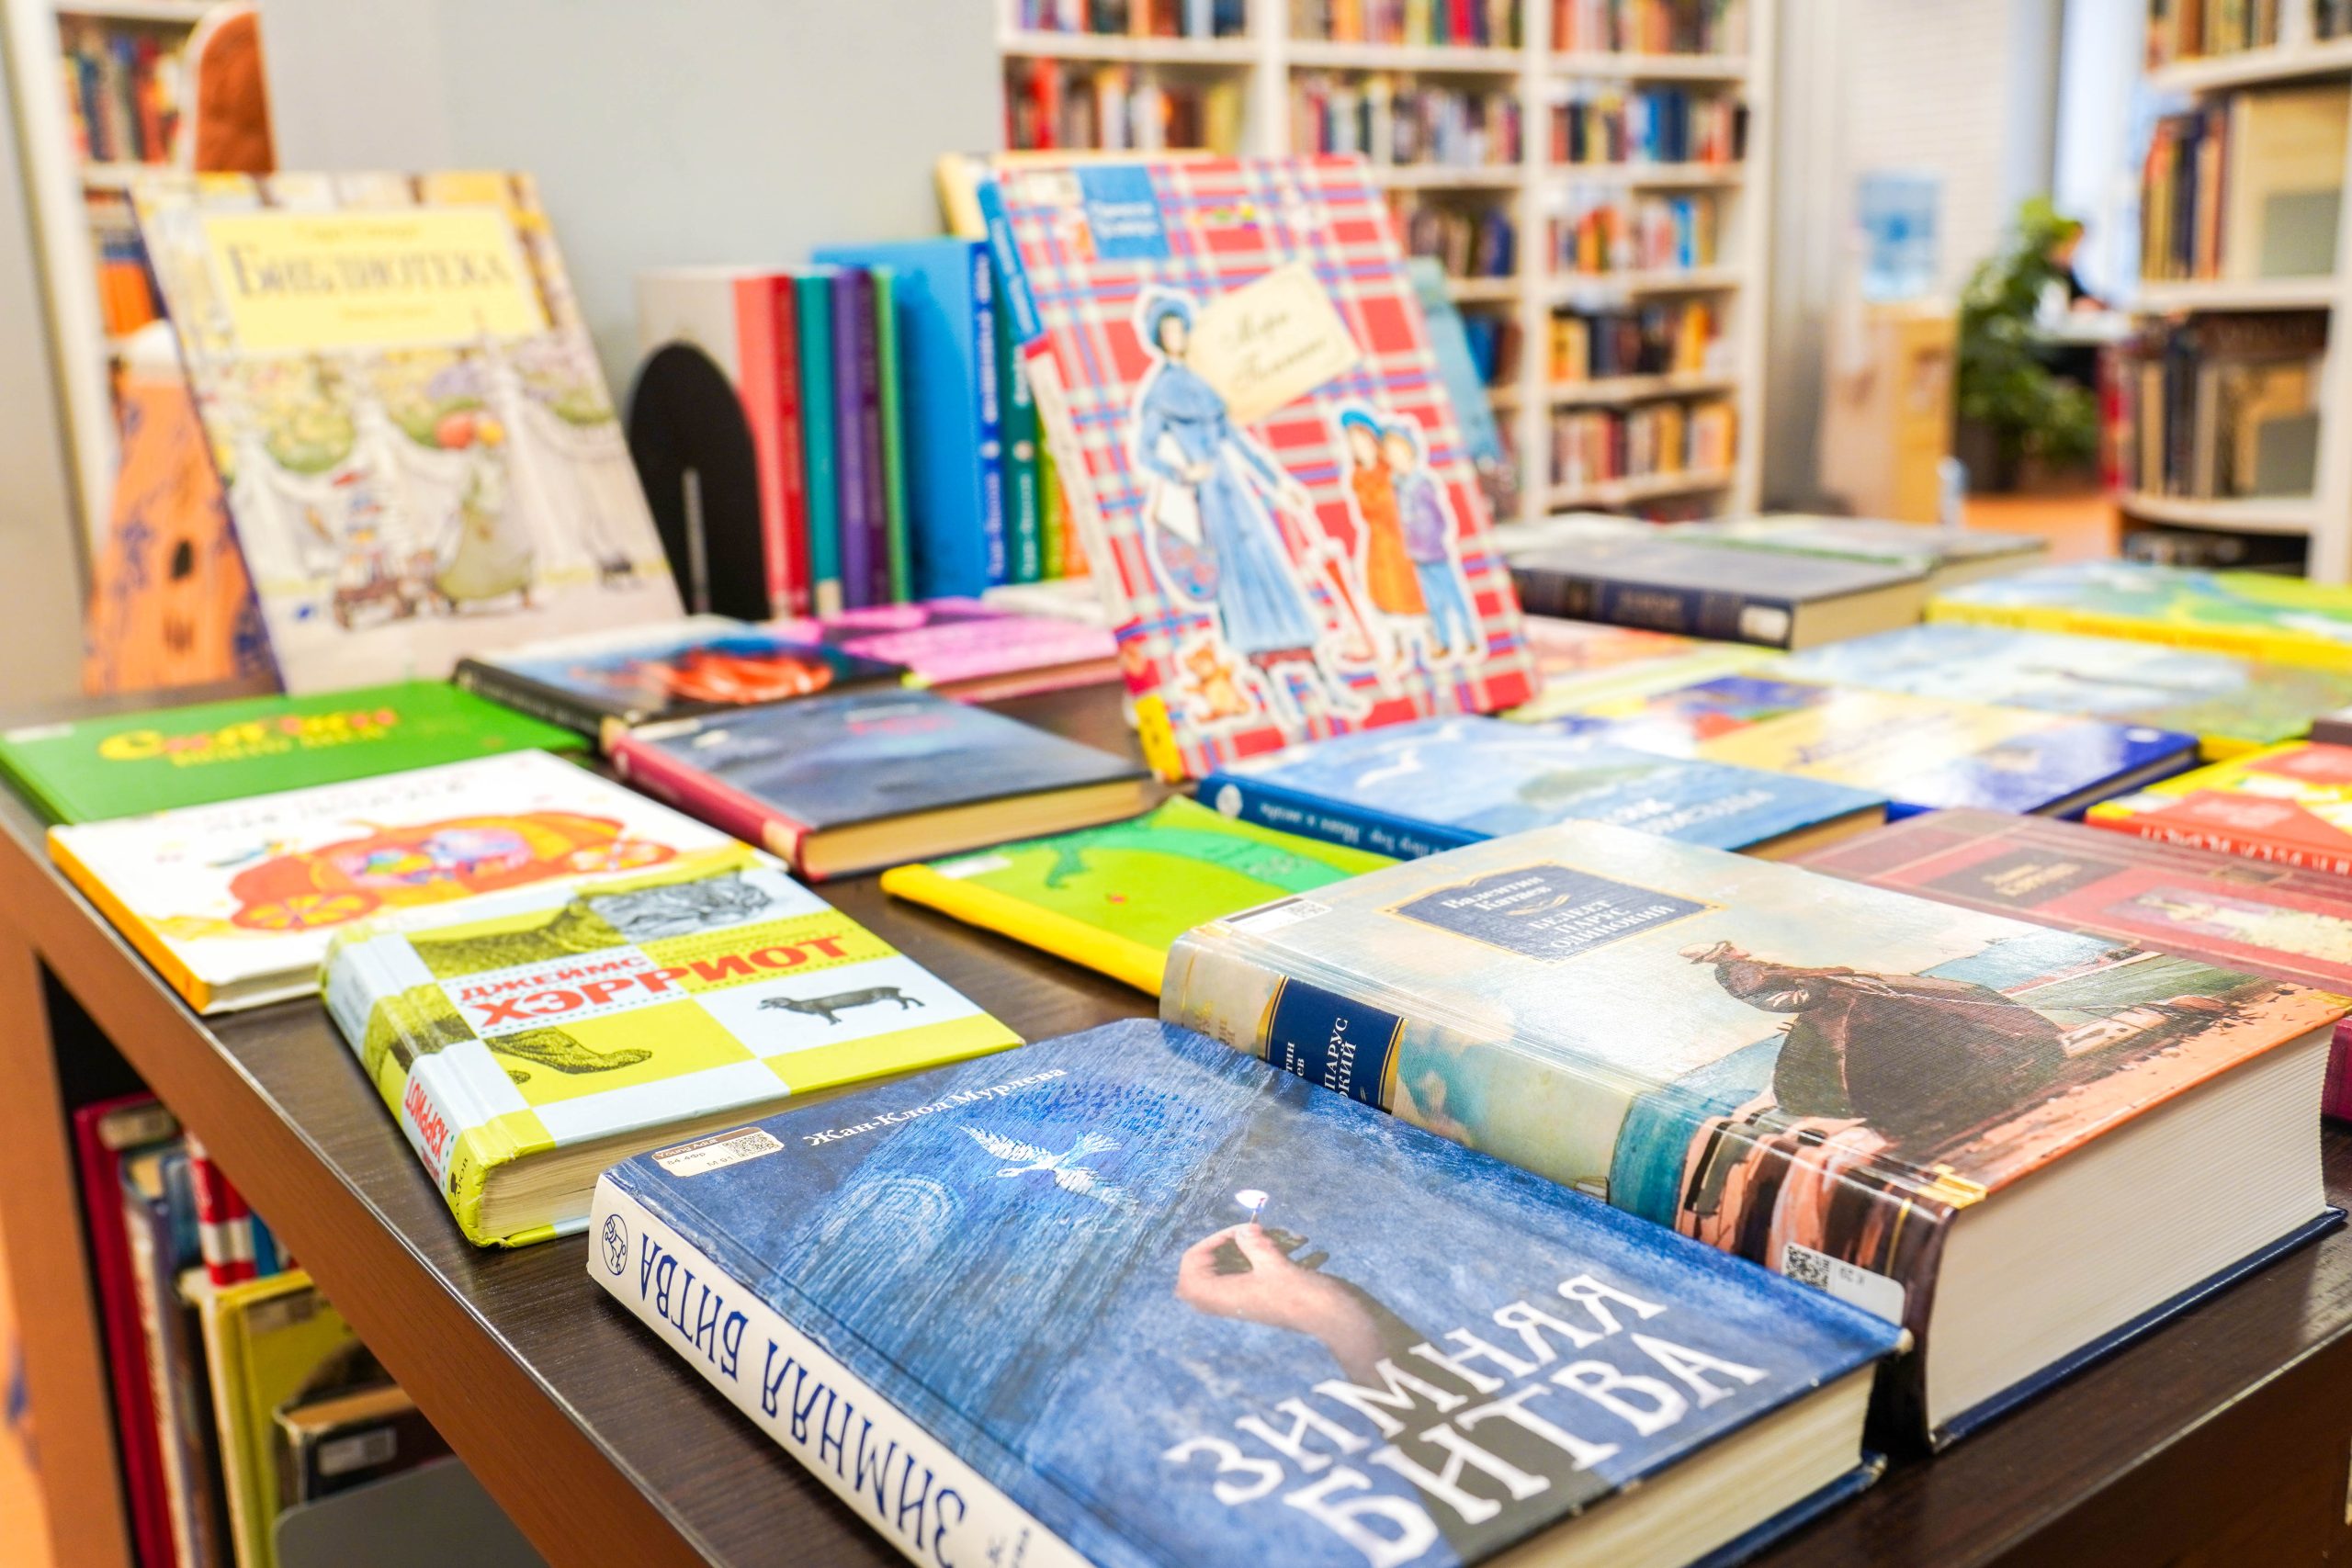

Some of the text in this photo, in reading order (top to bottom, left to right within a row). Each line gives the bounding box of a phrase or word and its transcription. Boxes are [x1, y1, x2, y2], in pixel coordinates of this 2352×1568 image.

[1441, 876, 1544, 909] Валентин
[1474, 886, 1553, 911] Катаев
[1528, 899, 1612, 931] БЕЛЕЕТ
[1555, 908, 1631, 934] ПАРУС
[1550, 904, 1676, 949] ОДИНОКИЙ
[460, 955, 648, 1001] ДЖЕЙМС
[471, 935, 848, 1027] ХЭРРИОТ
[1324, 1017, 1349, 1090] ПАРУС
[405, 1077, 449, 1163] ХЭРРИОТ
[803, 1068, 1068, 1146] Жан-Клод Мурлева
[656, 1146, 691, 1158] Young
[639, 1233, 967, 1568] ЗИМНЯЯ БИТВА
[1164, 1273, 1668, 1505] ЗИМНЯЯ
[1283, 1334, 1770, 1568] БИТВА
